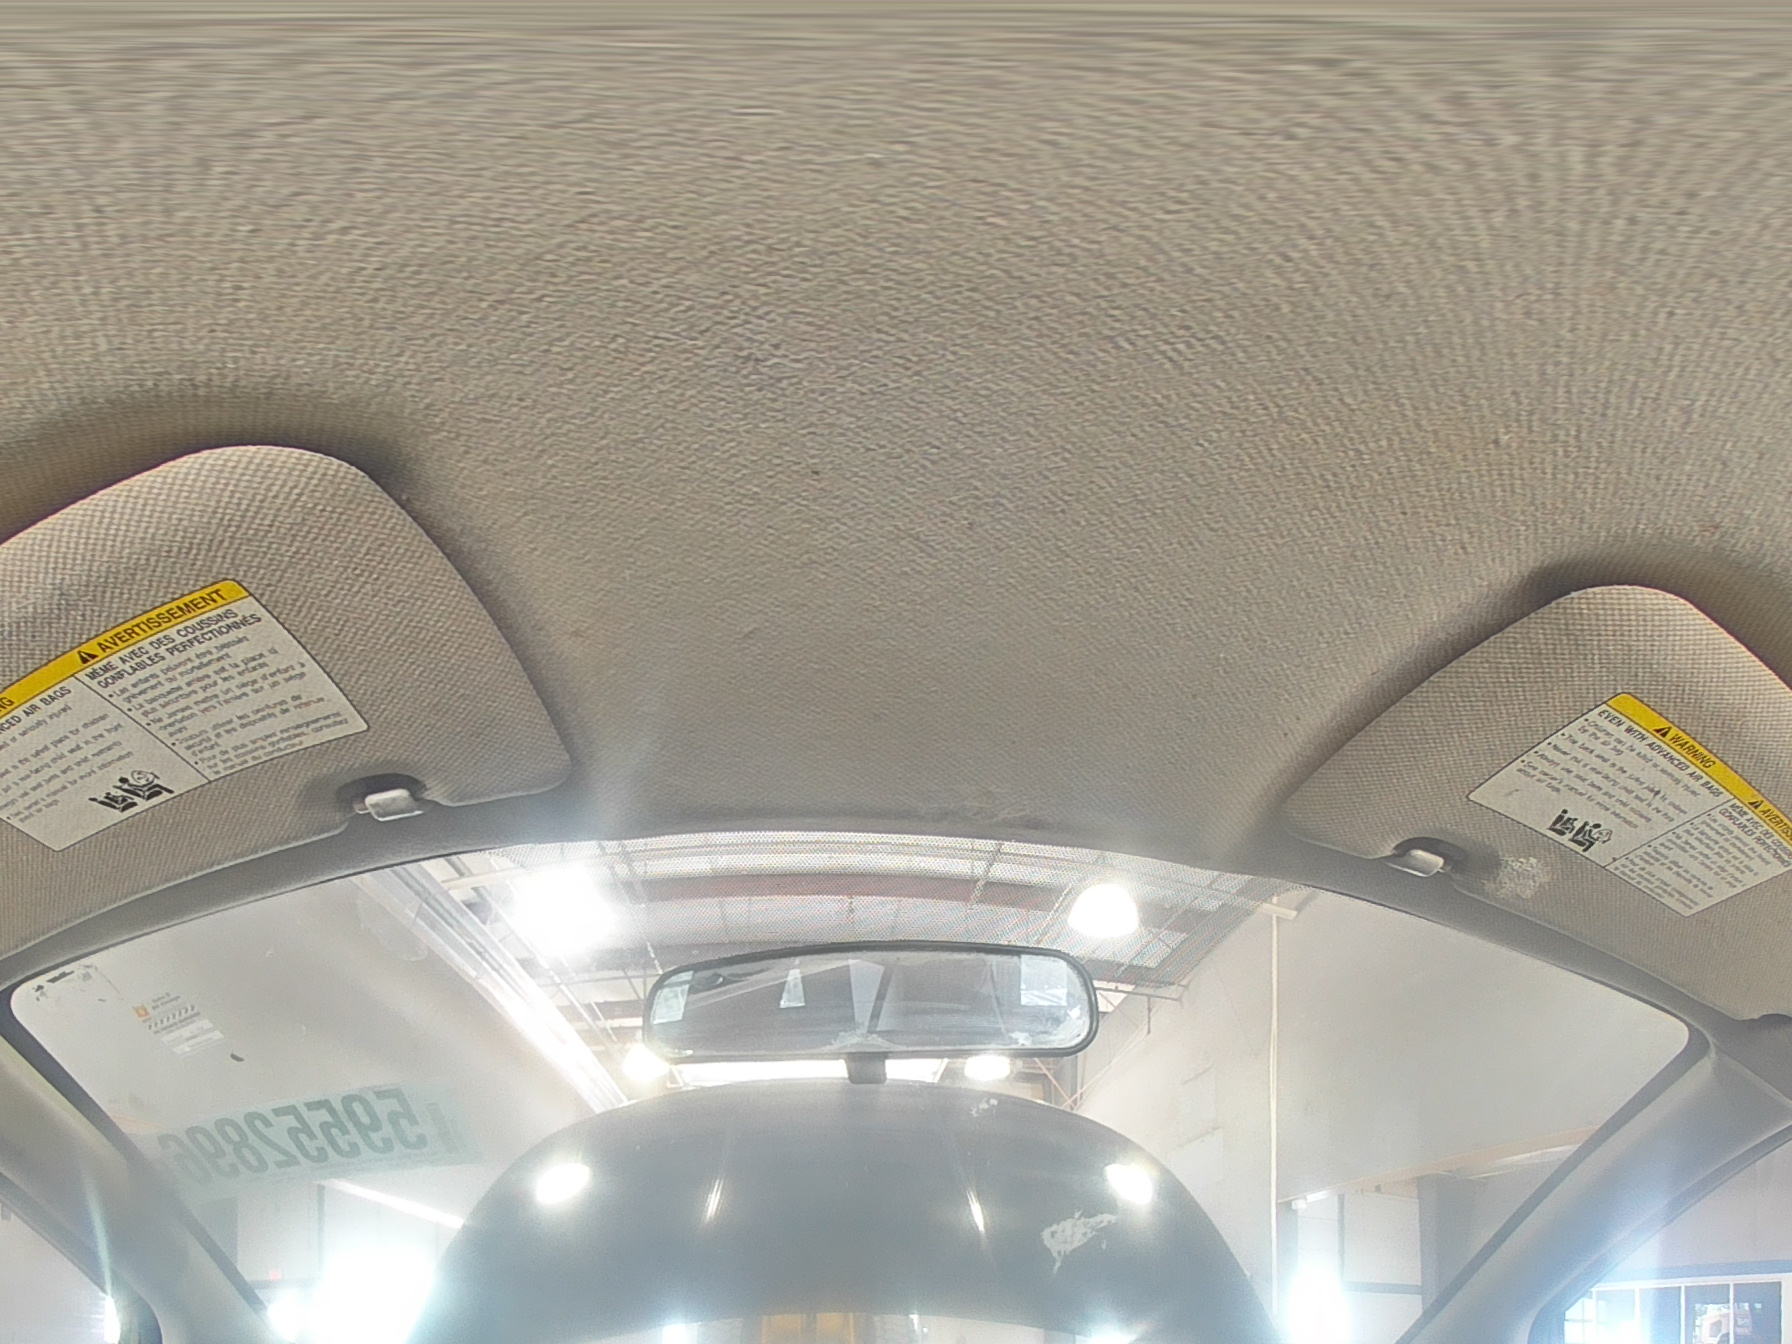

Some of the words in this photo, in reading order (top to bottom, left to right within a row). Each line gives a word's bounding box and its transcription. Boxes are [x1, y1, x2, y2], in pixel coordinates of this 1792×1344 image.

[97, 588, 229, 653] AVERTISSEMENT
[118, 646, 150, 665] AVEC
[148, 634, 176, 650] DES
[176, 608, 239, 638] COUSSINS
[165, 613, 262, 656] PERFECTIONNÉS
[22, 704, 41, 717] AIR
[39, 686, 72, 706] BAGS
[1597, 709, 1626, 728] EVEN
[1624, 725, 1649, 742] WITH
[1644, 742, 1690, 772] ADVANCED
[1685, 771, 1704, 782] AIR
[1700, 780, 1724, 798] BAGS
[1668, 730, 1716, 769] WARNING
